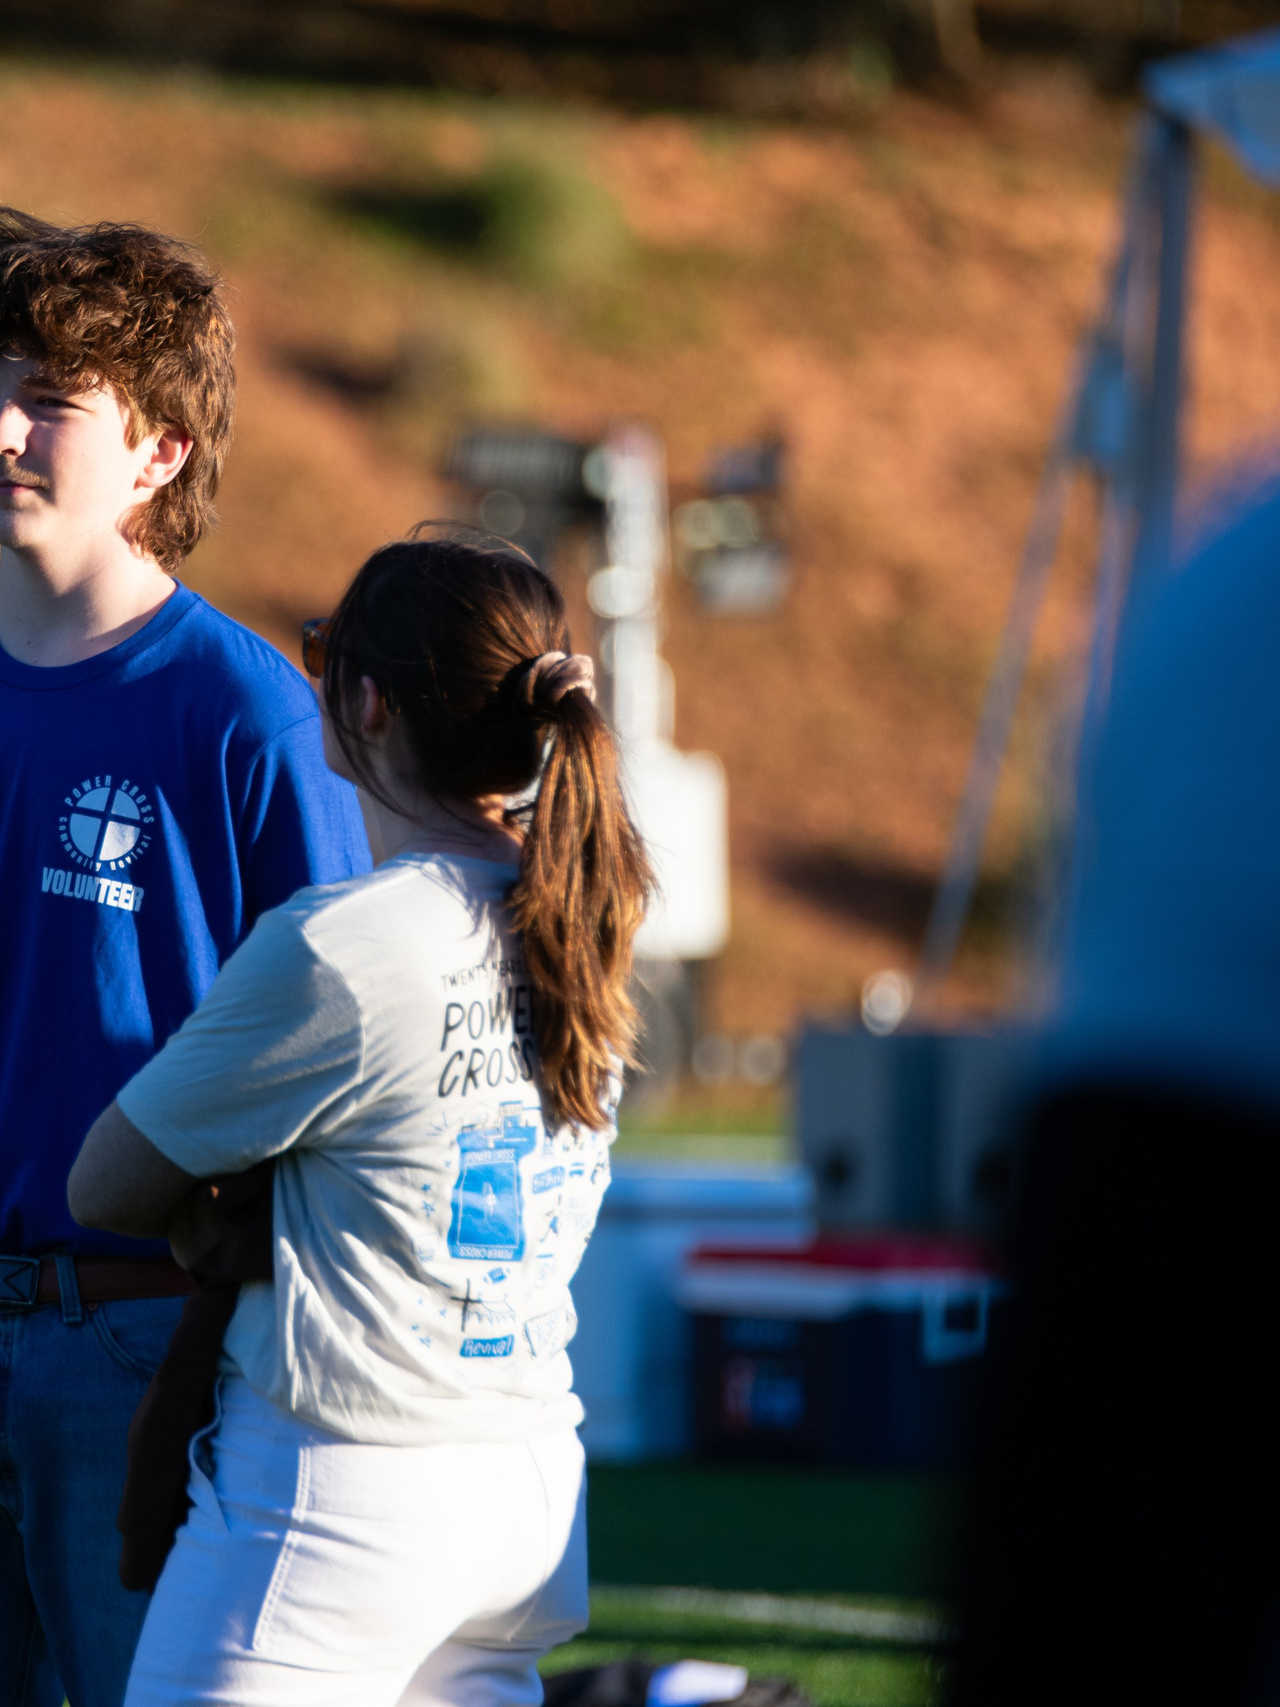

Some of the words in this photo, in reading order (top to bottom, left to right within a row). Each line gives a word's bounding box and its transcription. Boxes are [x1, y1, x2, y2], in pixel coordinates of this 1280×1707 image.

[64, 775, 112, 807] POWER
[121, 779, 155, 823] CROSS
[58, 816, 102, 872] Community
[110, 834, 152, 871] Revival
[41, 867, 145, 912] VOLUNTEER
[438, 1038, 535, 1098] CROSS
[465, 1336, 512, 1356] Revival
